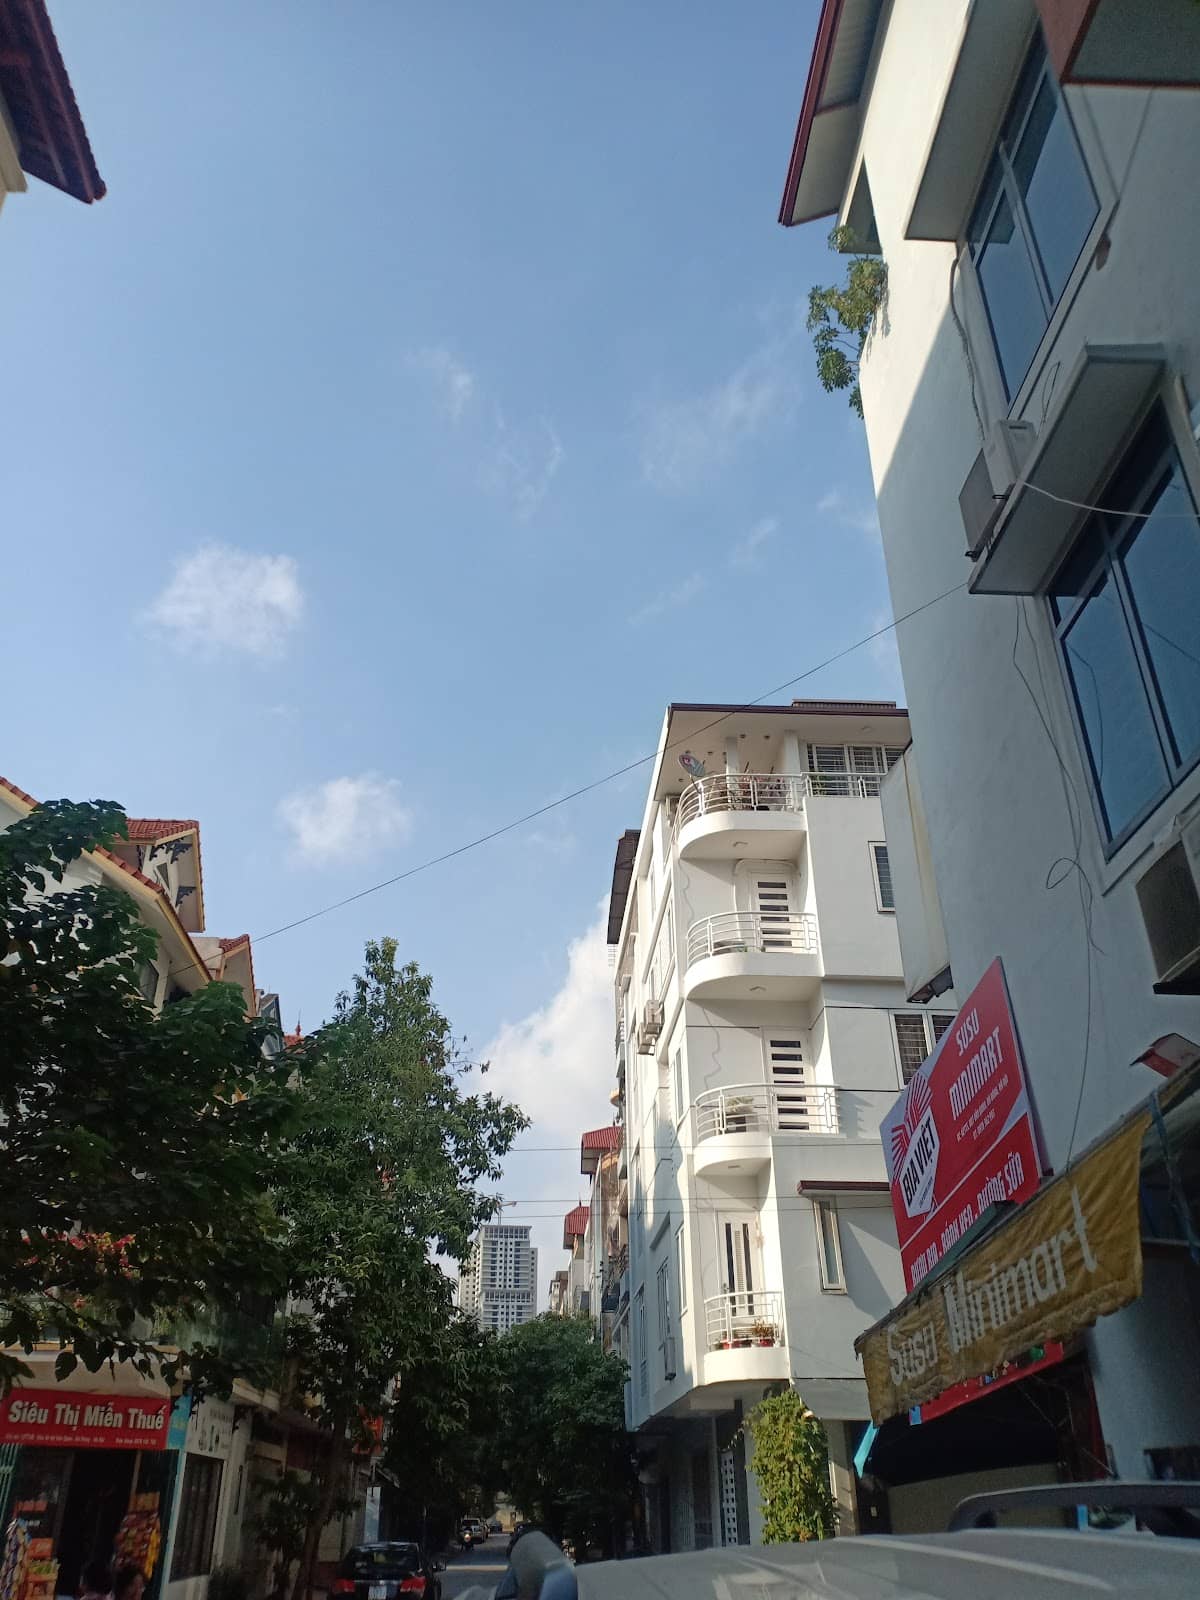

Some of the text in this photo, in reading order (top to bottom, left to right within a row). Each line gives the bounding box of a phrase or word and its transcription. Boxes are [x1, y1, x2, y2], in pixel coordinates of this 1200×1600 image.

[955, 1008, 980, 1057] SUSU
[949, 1026, 1003, 1121] MINIMART
[902, 1158, 920, 1208] BIA
[914, 1116, 936, 1175] VIỆT
[1004, 1151, 1025, 1196] SỮA
[887, 1183, 1098, 1386] Susu Minimart
[8, 1400, 49, 1424] Siêu
[54, 1404, 80, 1430] Thị
[83, 1402, 123, 1428] Miễn
[127, 1405, 167, 1430] Thuế
